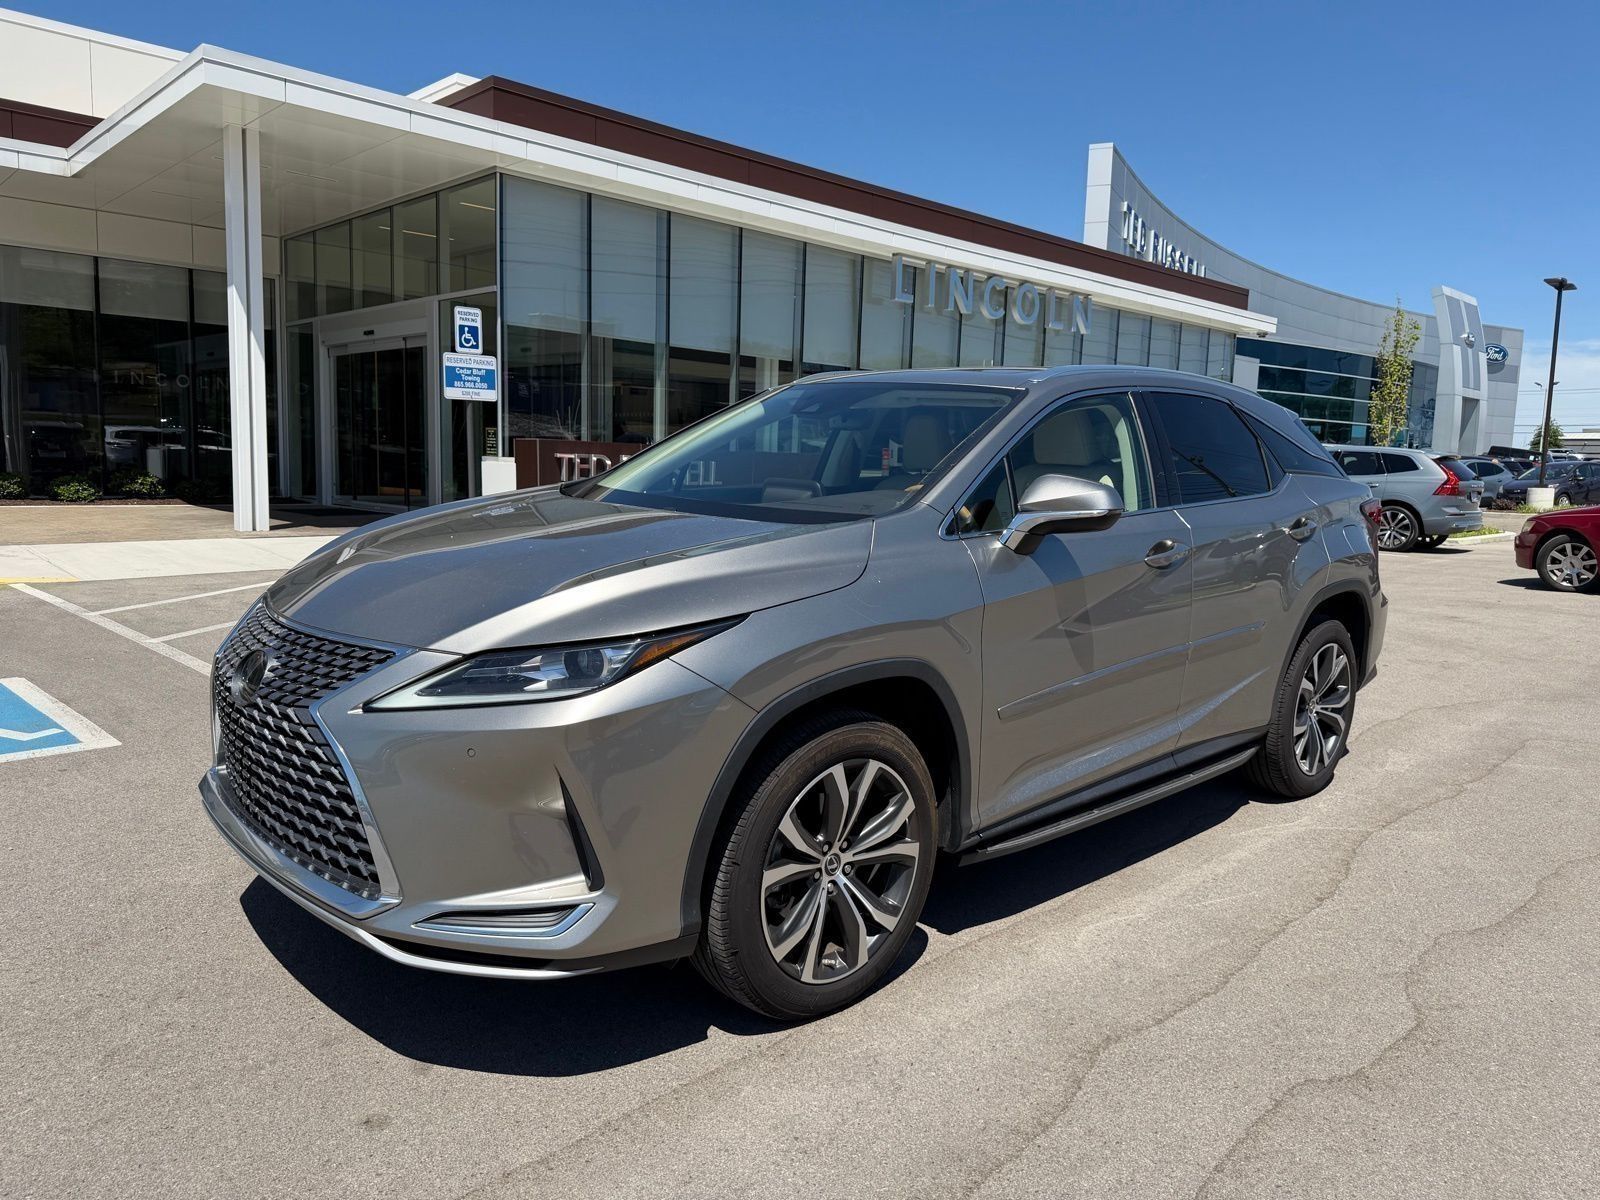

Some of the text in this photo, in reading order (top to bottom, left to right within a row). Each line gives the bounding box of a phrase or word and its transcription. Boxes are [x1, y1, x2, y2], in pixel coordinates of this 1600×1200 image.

[1123, 201, 1147, 254] TED
[892, 253, 1092, 335] LINCOLN
[473, 359, 494, 367] PARKING
[1486, 346, 1503, 360] Ford
[461, 374, 480, 382] Towing
[554, 452, 612, 482] TED
